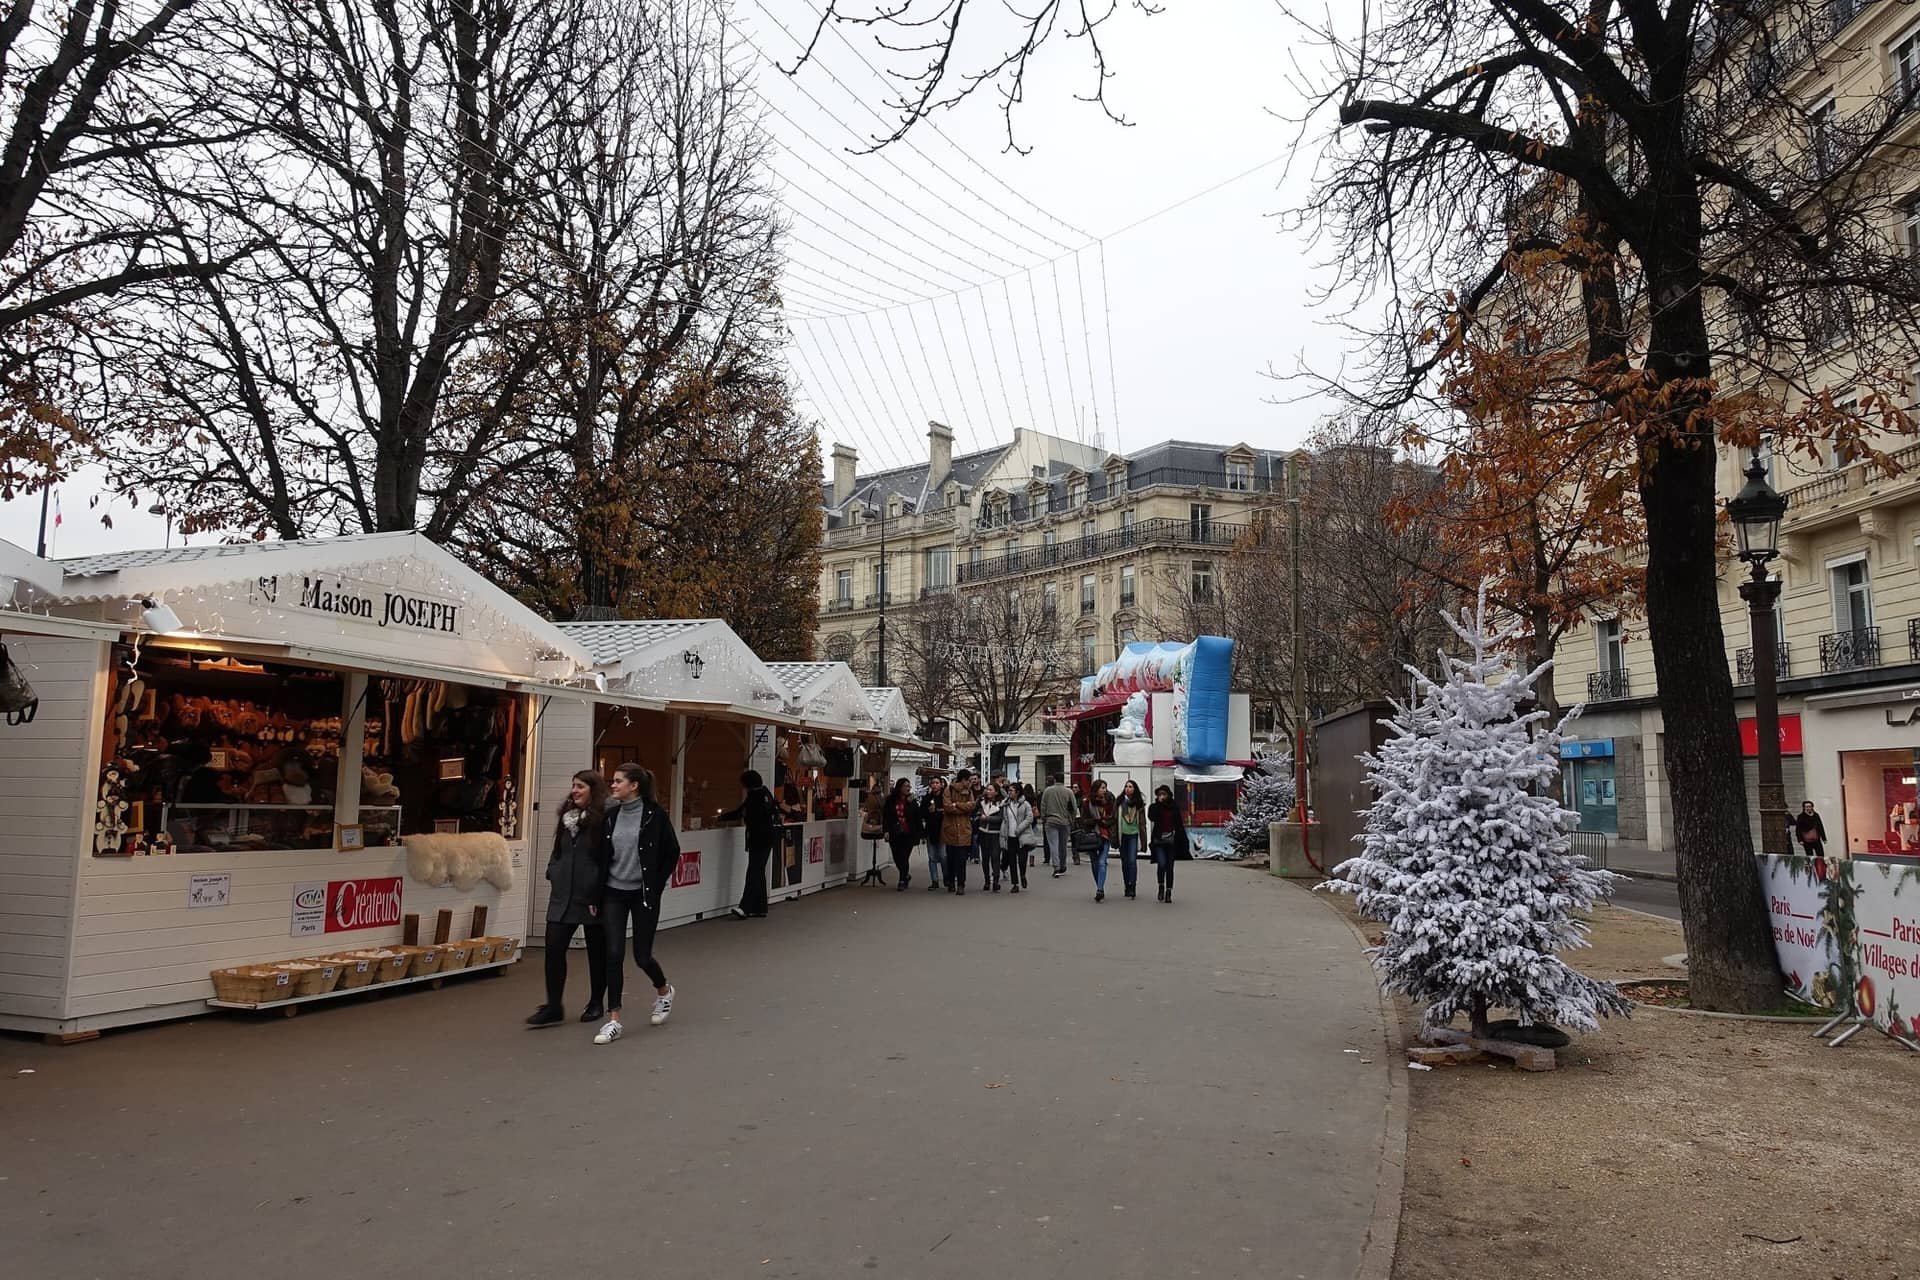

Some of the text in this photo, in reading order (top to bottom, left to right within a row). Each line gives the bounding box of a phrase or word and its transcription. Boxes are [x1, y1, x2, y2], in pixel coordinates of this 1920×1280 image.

[300, 576, 458, 633] Maison JOSEPH
[1771, 895, 1791, 917] Paris
[1784, 923, 1795, 944] de
[1796, 926, 1816, 949] Noë
[1892, 917, 1920, 945] Paris
[1863, 943, 1920, 980] Villages d
